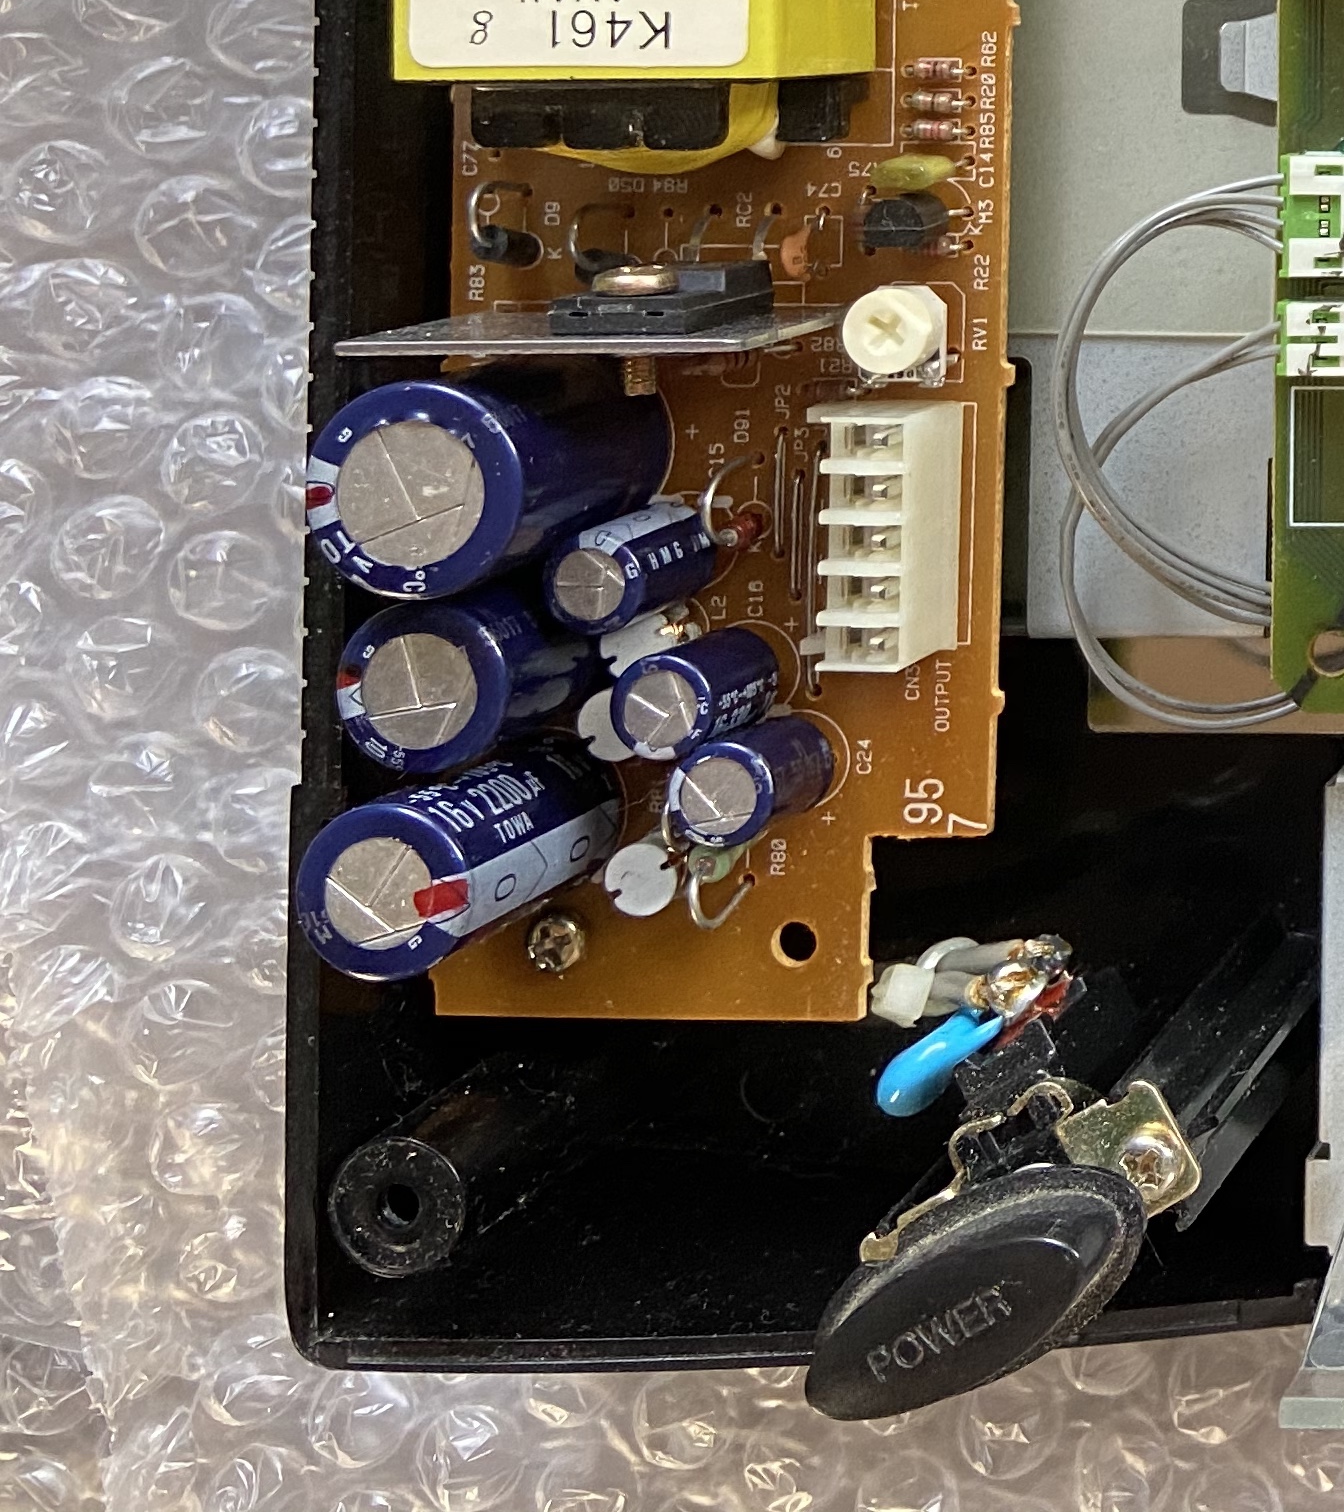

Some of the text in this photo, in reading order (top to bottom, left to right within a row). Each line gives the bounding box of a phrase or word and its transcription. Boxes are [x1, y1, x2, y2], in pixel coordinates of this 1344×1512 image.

[549, 10, 672, 50] K461
[979, 73, 997, 109] R20
[979, 112, 996, 149] R85
[461, 140, 482, 177] C77
[978, 153, 996, 189] C14
[805, 182, 843, 199] C74
[543, 201, 562, 227] D9
[735, 192, 754, 228] RC2
[468, 264, 486, 302] R83
[973, 254, 991, 292] R22
[972, 318, 989, 352] RV1
[774, 383, 792, 420] JP2
[733, 408, 752, 443] D91
[710, 594, 727, 620] L2
[934, 659, 954, 732] OUTPUT
[856, 738, 873, 775] C24
[904, 778, 947, 824] 95
[494, 810, 537, 844] TOWA
[946, 812, 987, 834] 7
[770, 838, 789, 877] R80
[866, 1280, 1017, 1382] POWER
